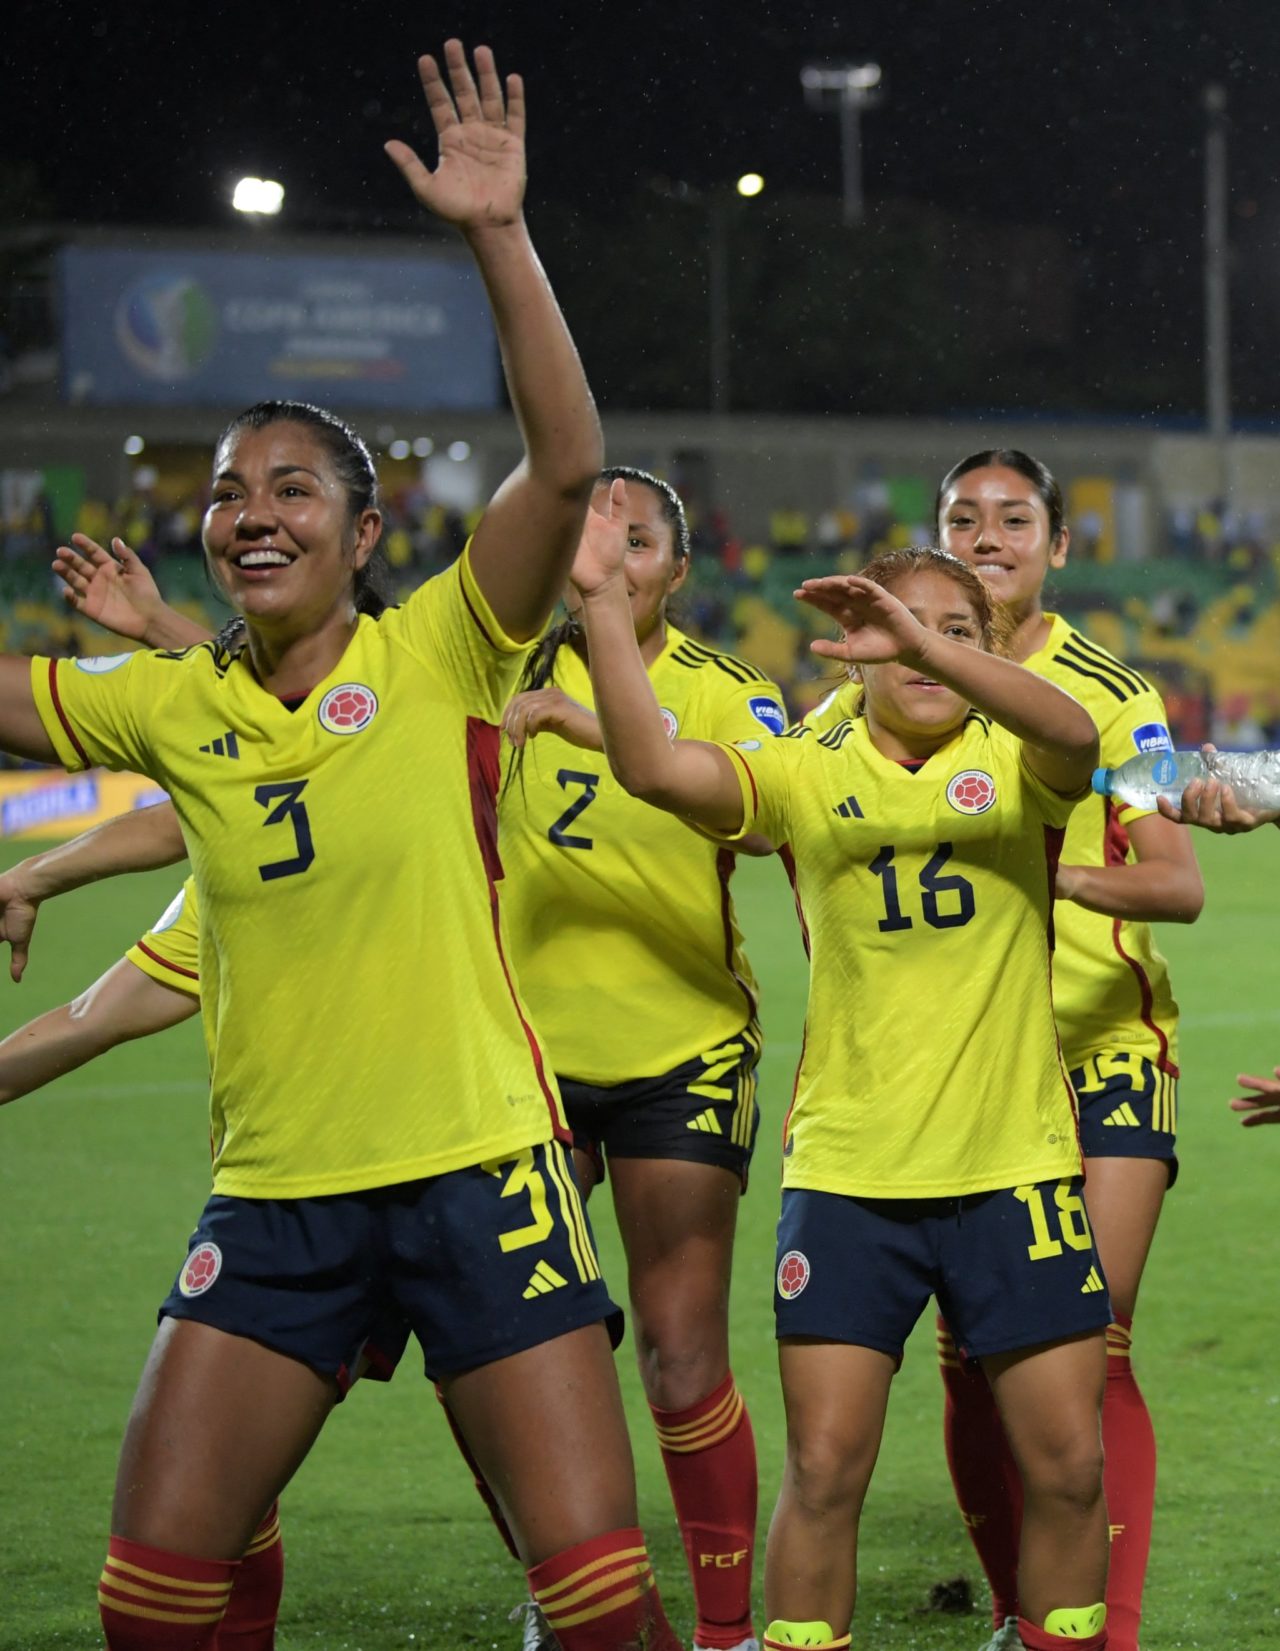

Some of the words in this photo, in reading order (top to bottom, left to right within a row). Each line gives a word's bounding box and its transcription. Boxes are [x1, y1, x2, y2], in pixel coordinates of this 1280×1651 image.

[255, 780, 316, 882] 3
[548, 770, 599, 851] 2
[868, 841, 976, 932] 16
[481, 1148, 554, 1253] 3
[700, 1548, 748, 1568] FCF
